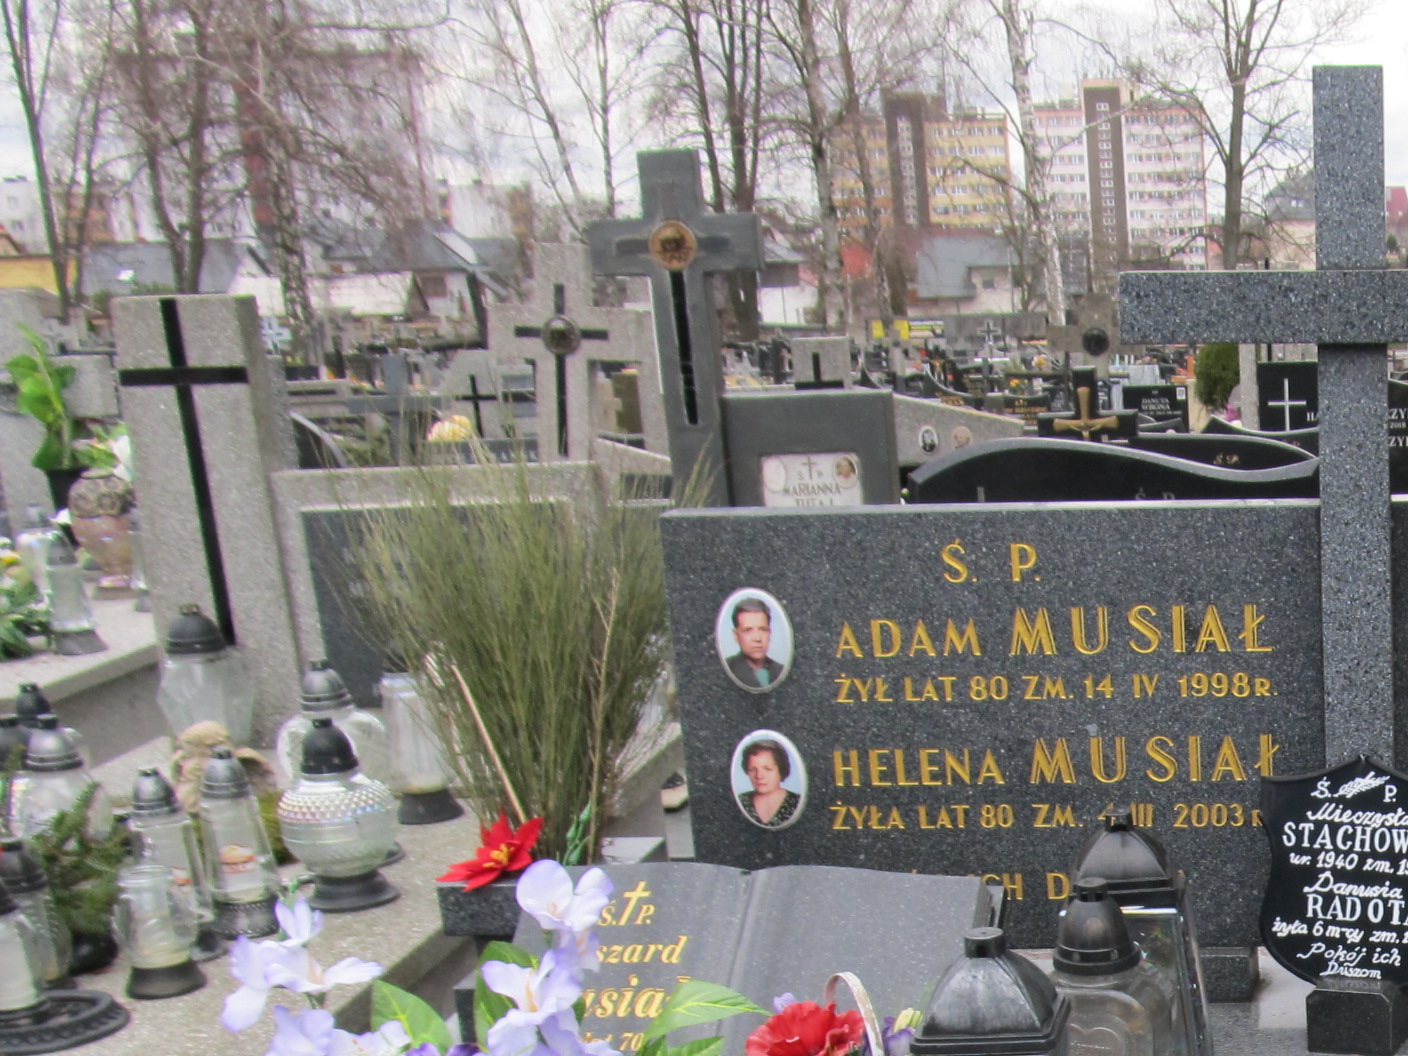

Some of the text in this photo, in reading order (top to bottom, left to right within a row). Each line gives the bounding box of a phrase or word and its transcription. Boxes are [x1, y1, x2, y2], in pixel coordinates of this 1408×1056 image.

[942, 539, 1042, 583] Ś. P.
[836, 603, 1273, 658] ADAM MUSIAŁ
[834, 673, 893, 703] ŻYŁ
[904, 676, 956, 702] LAT
[969, 675, 1009, 701] 80
[1022, 675, 1074, 700] ZM.
[1083, 674, 1114, 698] 14
[1132, 674, 1159, 698] IV
[832, 734, 1280, 787] HELENA MUSIAŁ
[1383, 785, 1397, 802] P.
[829, 801, 905, 830] ŻYŁA
[917, 804, 970, 829] LAT
[980, 804, 1014, 829] 80
[1032, 804, 1083, 828] ZM.
[1289, 852, 1310, 866] ur.
[1316, 852, 1358, 870] 1940
[1363, 858, 1394, 874] zm.
[1303, 871, 1403, 898] Danusia
[634, 903, 656, 925] P.
[1272, 917, 1308, 937] żyła
[1313, 921, 1324, 936] 6
[1369, 930, 1399, 944] zm.
[595, 935, 690, 964] szard
[1297, 942, 1401, 967] Pokój ich
[1320, 962, 1381, 979] Duszom
